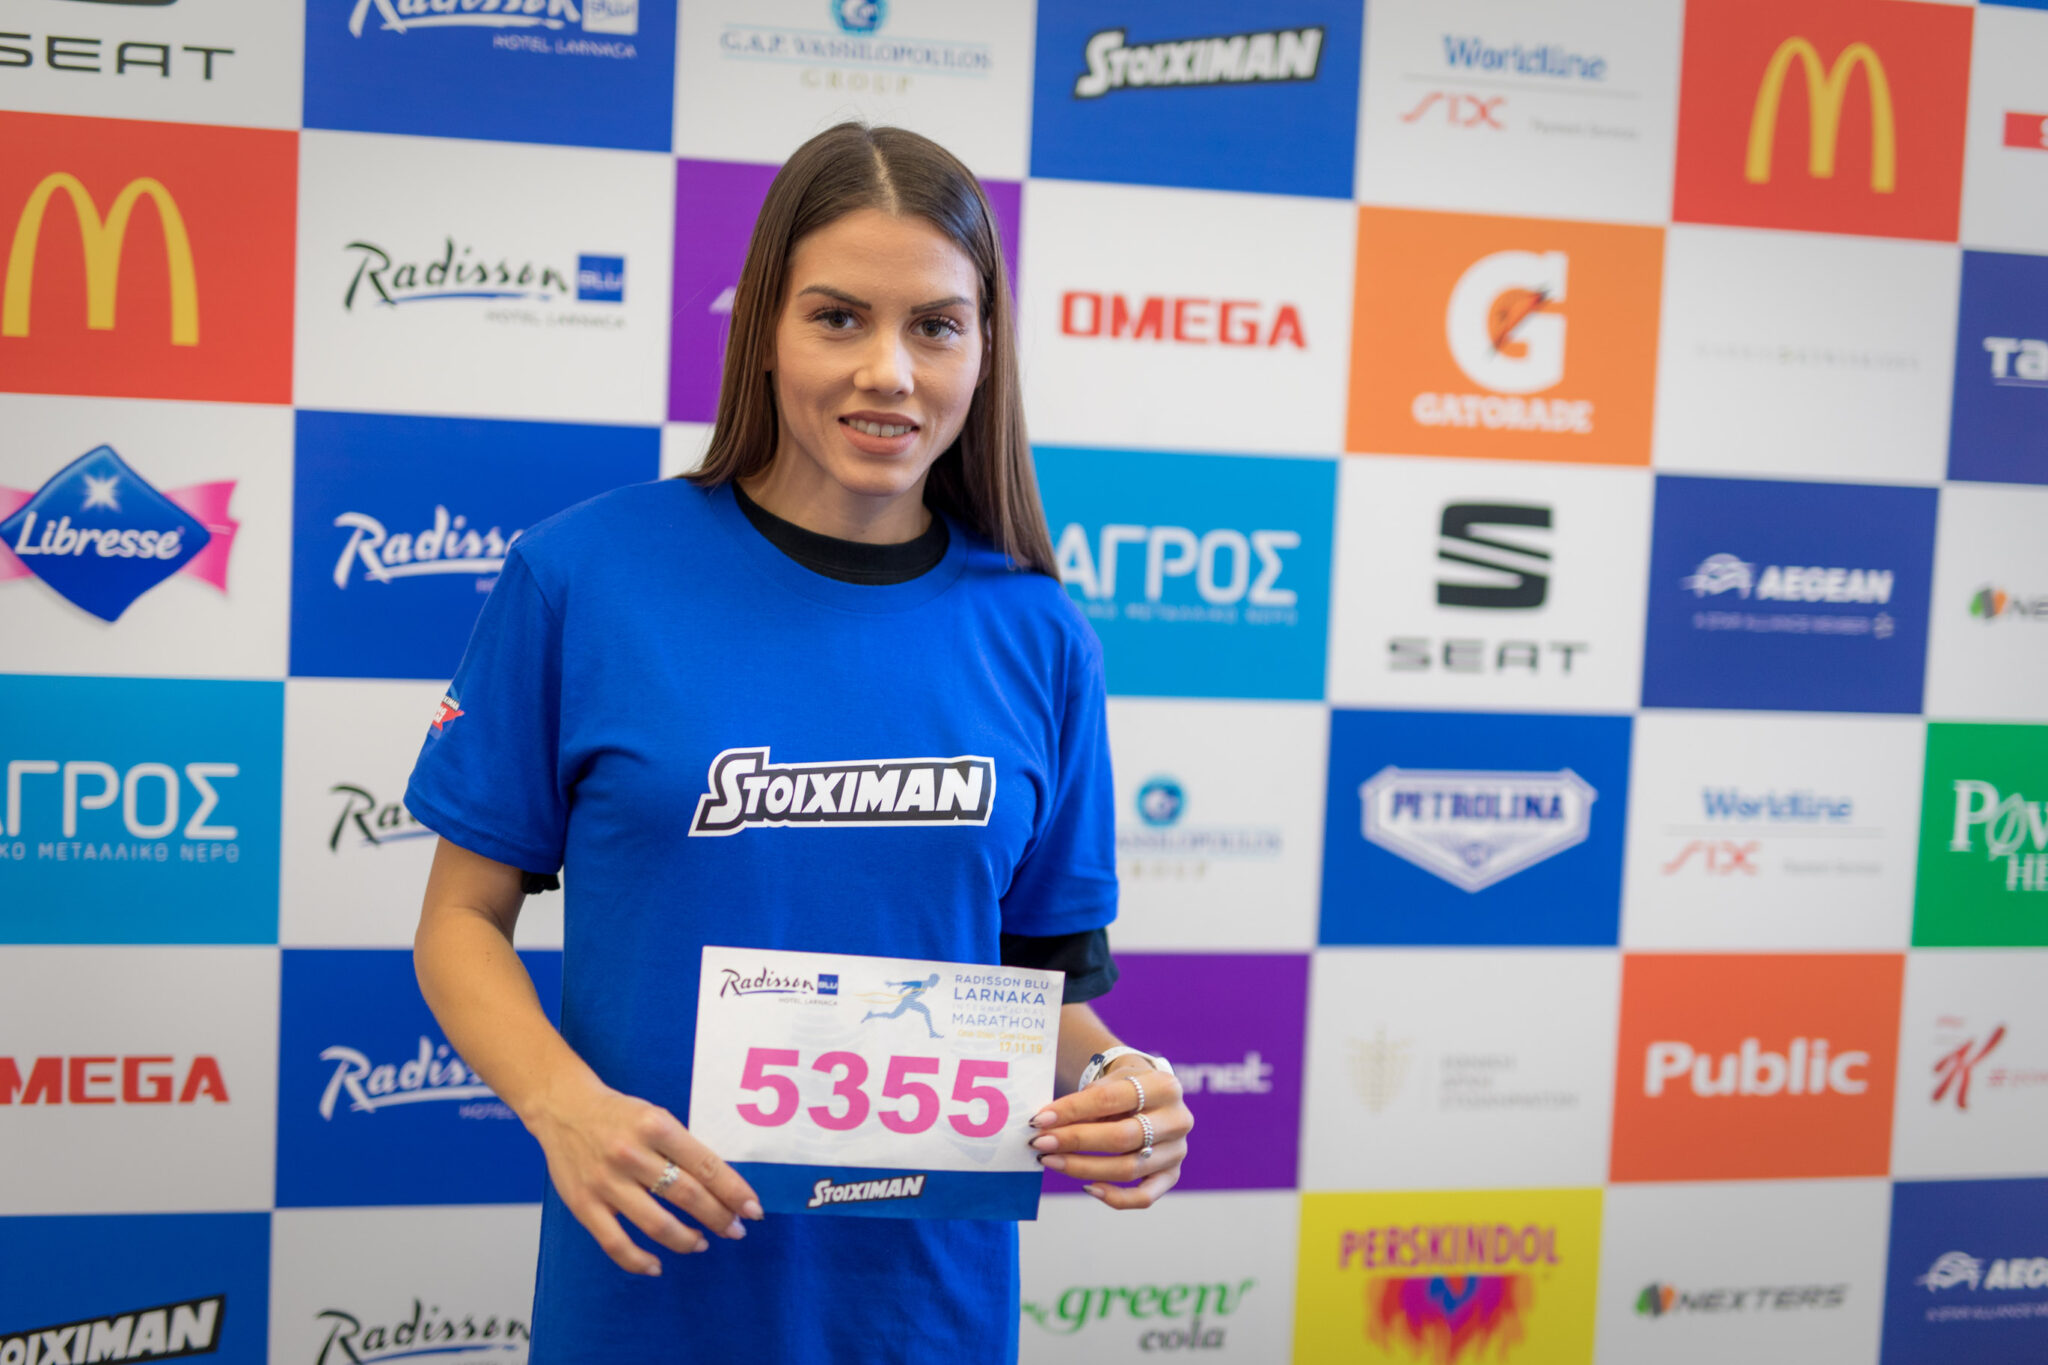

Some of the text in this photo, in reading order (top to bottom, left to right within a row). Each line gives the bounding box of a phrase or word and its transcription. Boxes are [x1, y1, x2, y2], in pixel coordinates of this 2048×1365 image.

[0, 32, 235, 81] SEAT
[493, 34, 551, 53] HOTEL
[1442, 33, 1608, 81] Worldline
[800, 68, 914, 94] GROUP
[344, 236, 568, 309] Radisson
[1061, 291, 1306, 348] OMEGA
[1411, 392, 1595, 434] GATORADE
[14, 511, 184, 560] Libresse
[1056, 522, 1302, 607] ΑΓΡΟΣ
[1755, 565, 1895, 604] AEGEAN
[1388, 636, 1589, 674] SEAT
[0, 760, 240, 840] ΓΡΟΣ
[1391, 791, 1564, 822] PETROLINA
[1702, 785, 1855, 822] Worldline
[181, 843, 240, 863] ΝΕΡΟ
[720, 966, 839, 998] Radisson BLU
[953, 987, 1046, 1006] LARNAKA
[955, 974, 1049, 990] RADISSON BLU
[952, 1013, 1045, 1029] MARATHON
[1643, 1037, 1870, 1098] Public
[736, 1047, 1010, 1138] 5355
[1339, 1224, 1560, 1270] PERSKINDOL
[1045, 1279, 1256, 1335] green
[1678, 1283, 1850, 1314] NEXTERS
[316, 1297, 530, 1365] Radisson
[1138, 1314, 1227, 1353] cola
